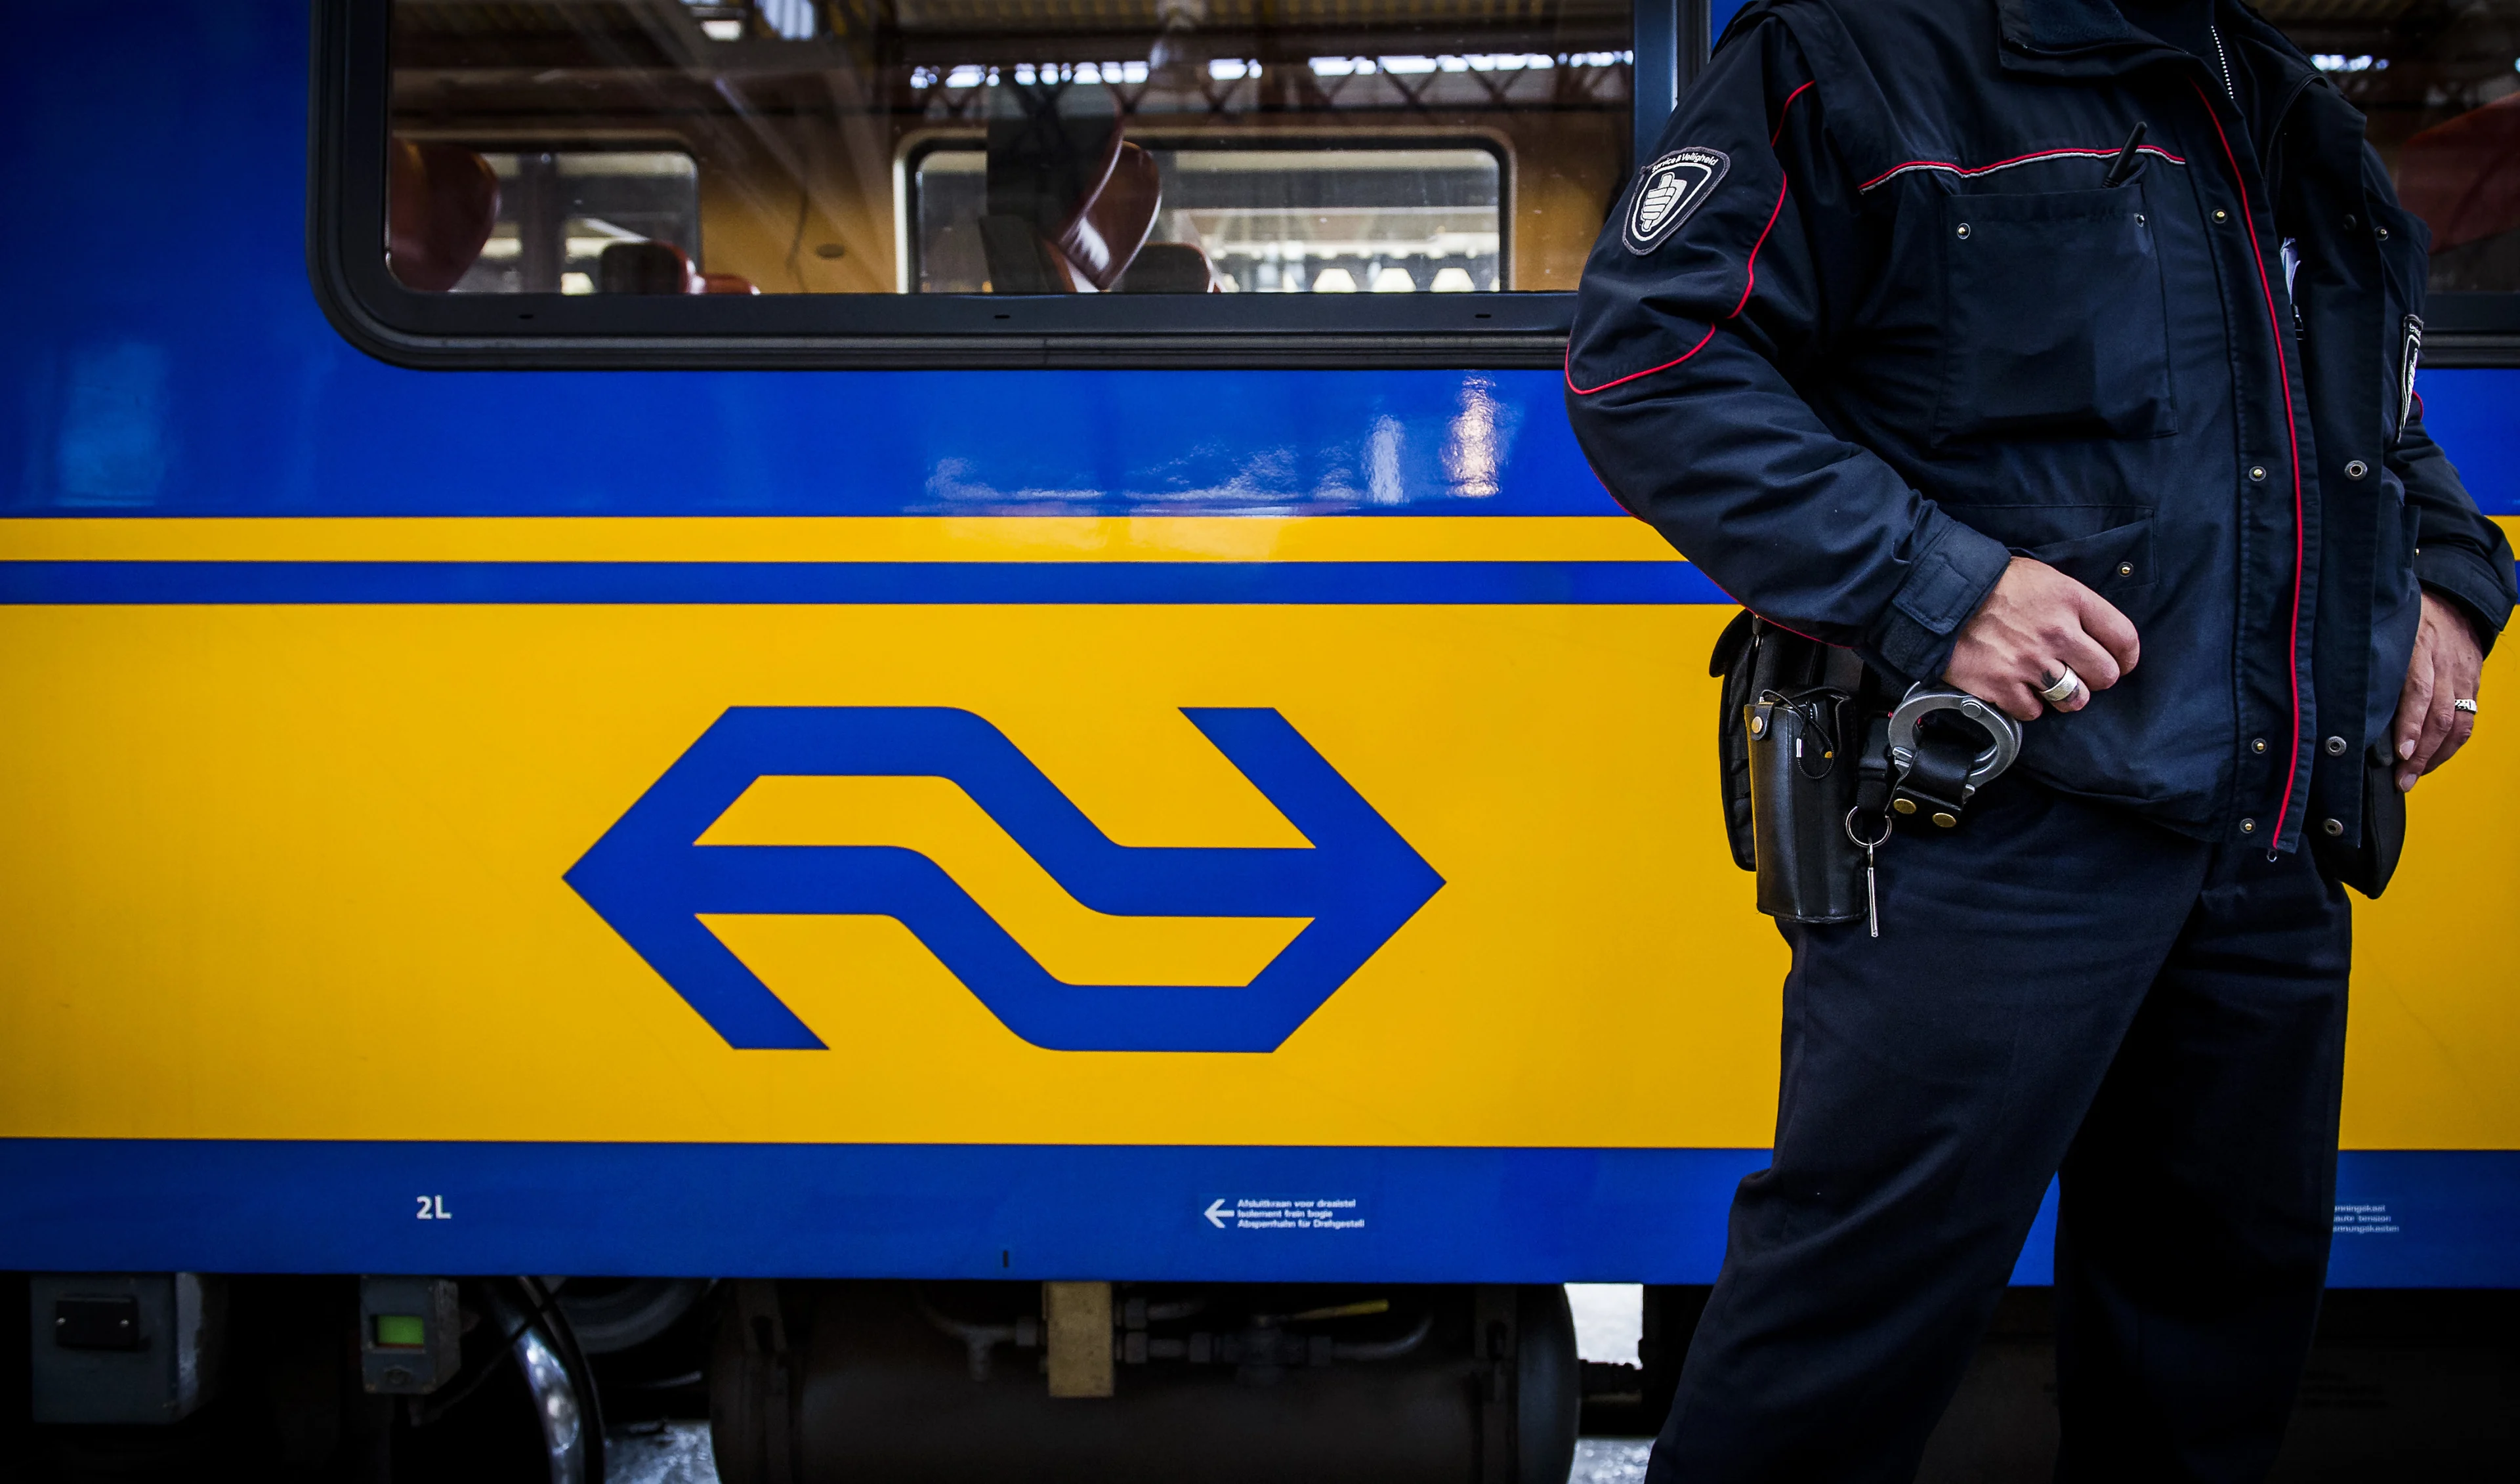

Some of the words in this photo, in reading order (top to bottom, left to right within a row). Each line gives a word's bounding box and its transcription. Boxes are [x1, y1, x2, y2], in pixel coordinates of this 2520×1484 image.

[1652, 157, 1675, 173] Service
[1681, 152, 1719, 166] Veiligheid
[416, 1195, 452, 1219] 2L
[1237, 1209, 1282, 1218] Isolement
[1284, 1209, 1305, 1218] frein
[1307, 1209, 1334, 1219] bogie
